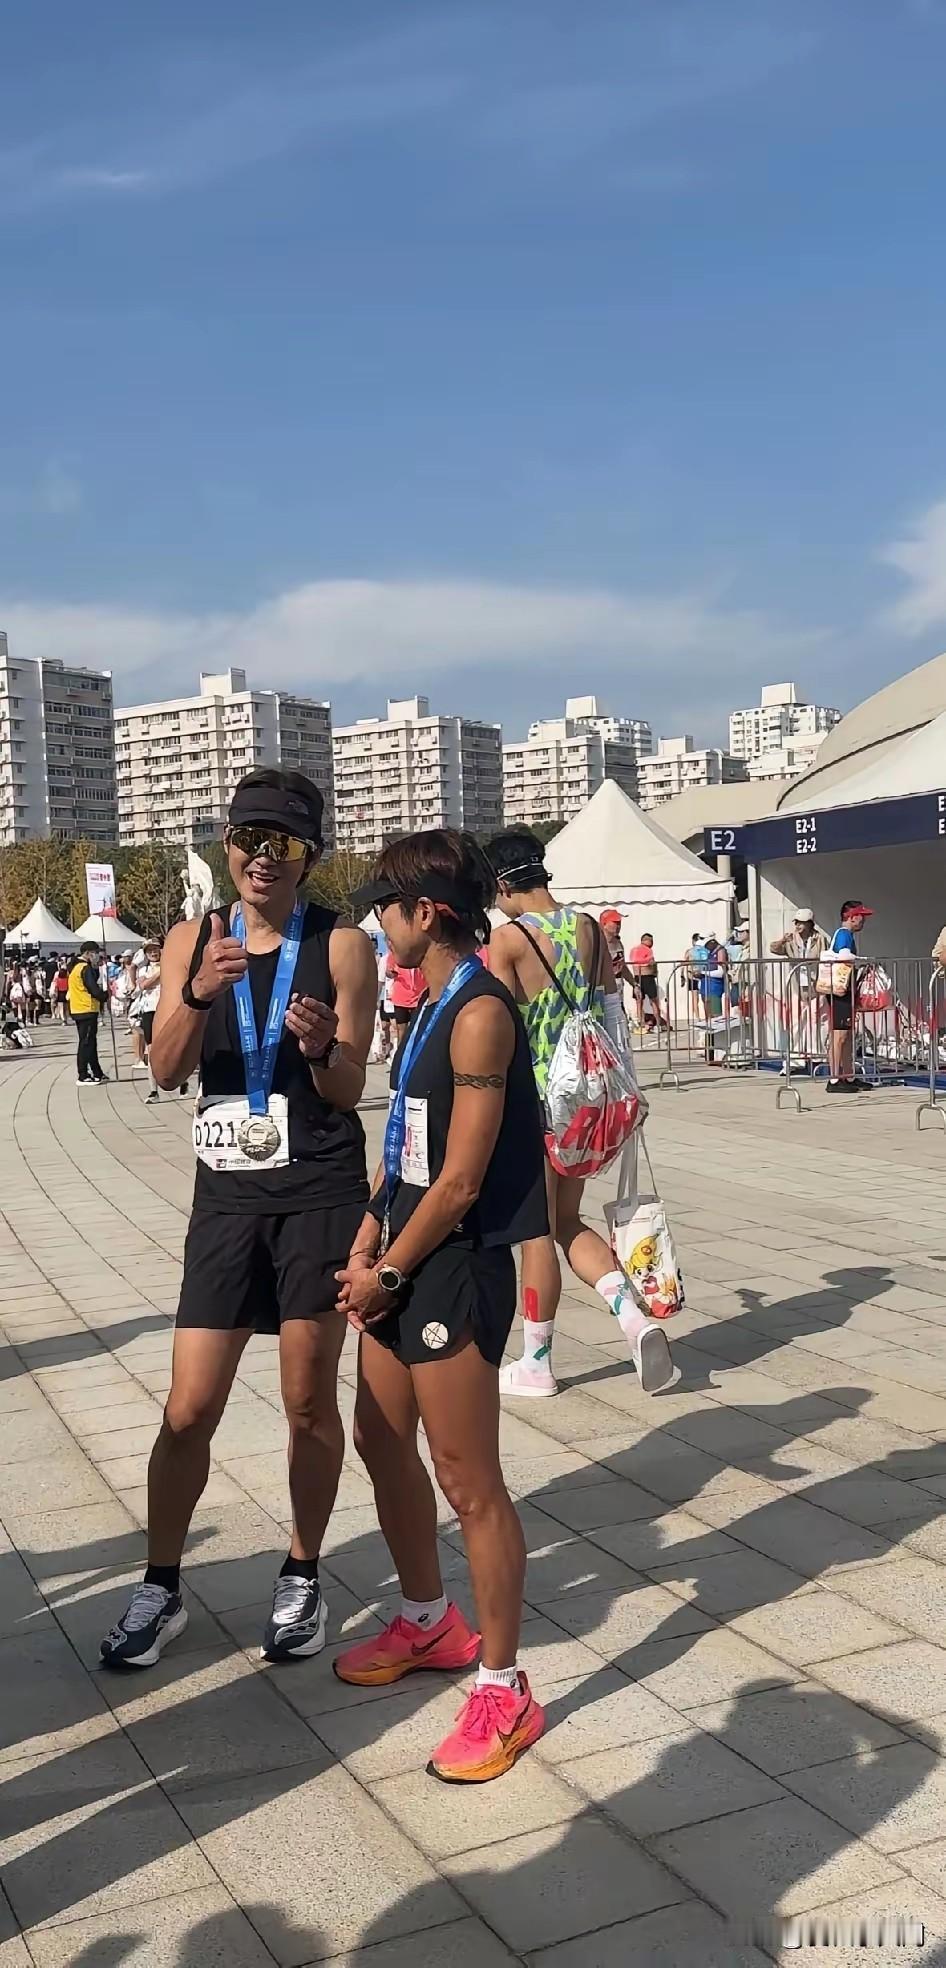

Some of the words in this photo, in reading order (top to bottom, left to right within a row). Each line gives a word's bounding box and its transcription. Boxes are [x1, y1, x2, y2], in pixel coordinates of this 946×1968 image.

[795, 817, 817, 834] E2-1
[710, 829, 737, 851] E2
[796, 837, 817, 854] E2-2
